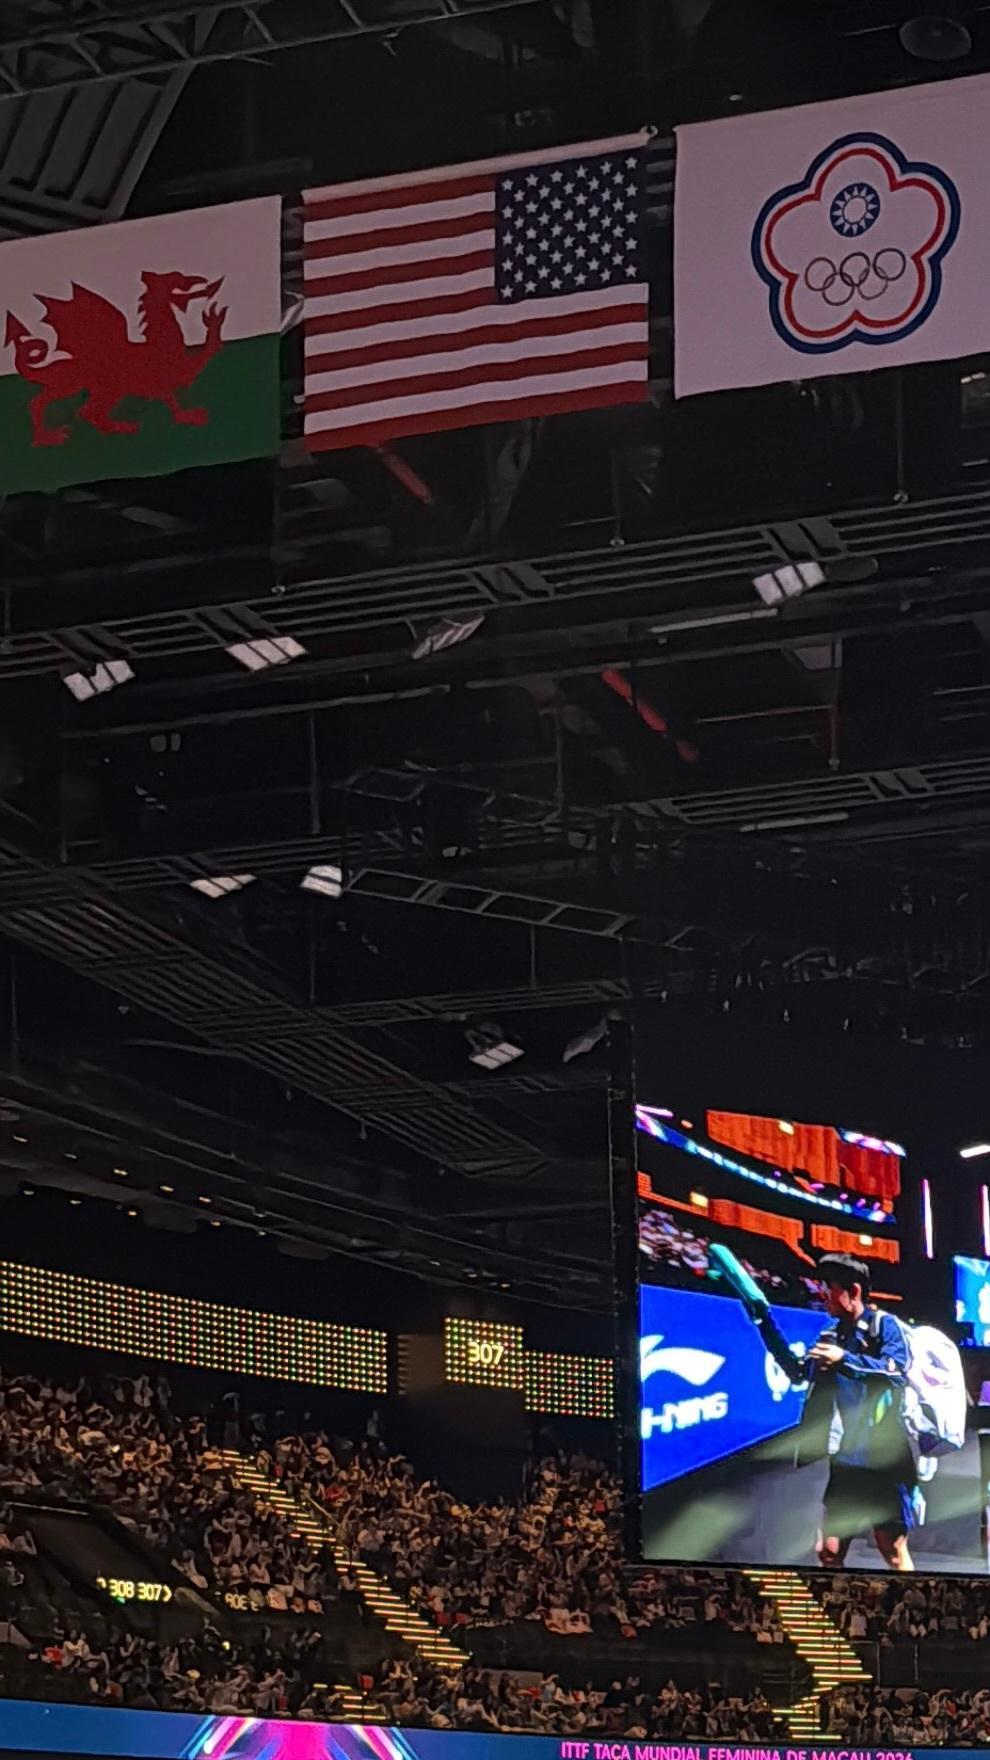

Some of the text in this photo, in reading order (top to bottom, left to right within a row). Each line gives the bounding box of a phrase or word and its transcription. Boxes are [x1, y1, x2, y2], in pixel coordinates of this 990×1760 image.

[468, 1341, 504, 1365] 307
[109, 1579, 135, 1599] 308
[138, 1582, 162, 1601] 307
[561, 1741, 590, 1760] ITTF
